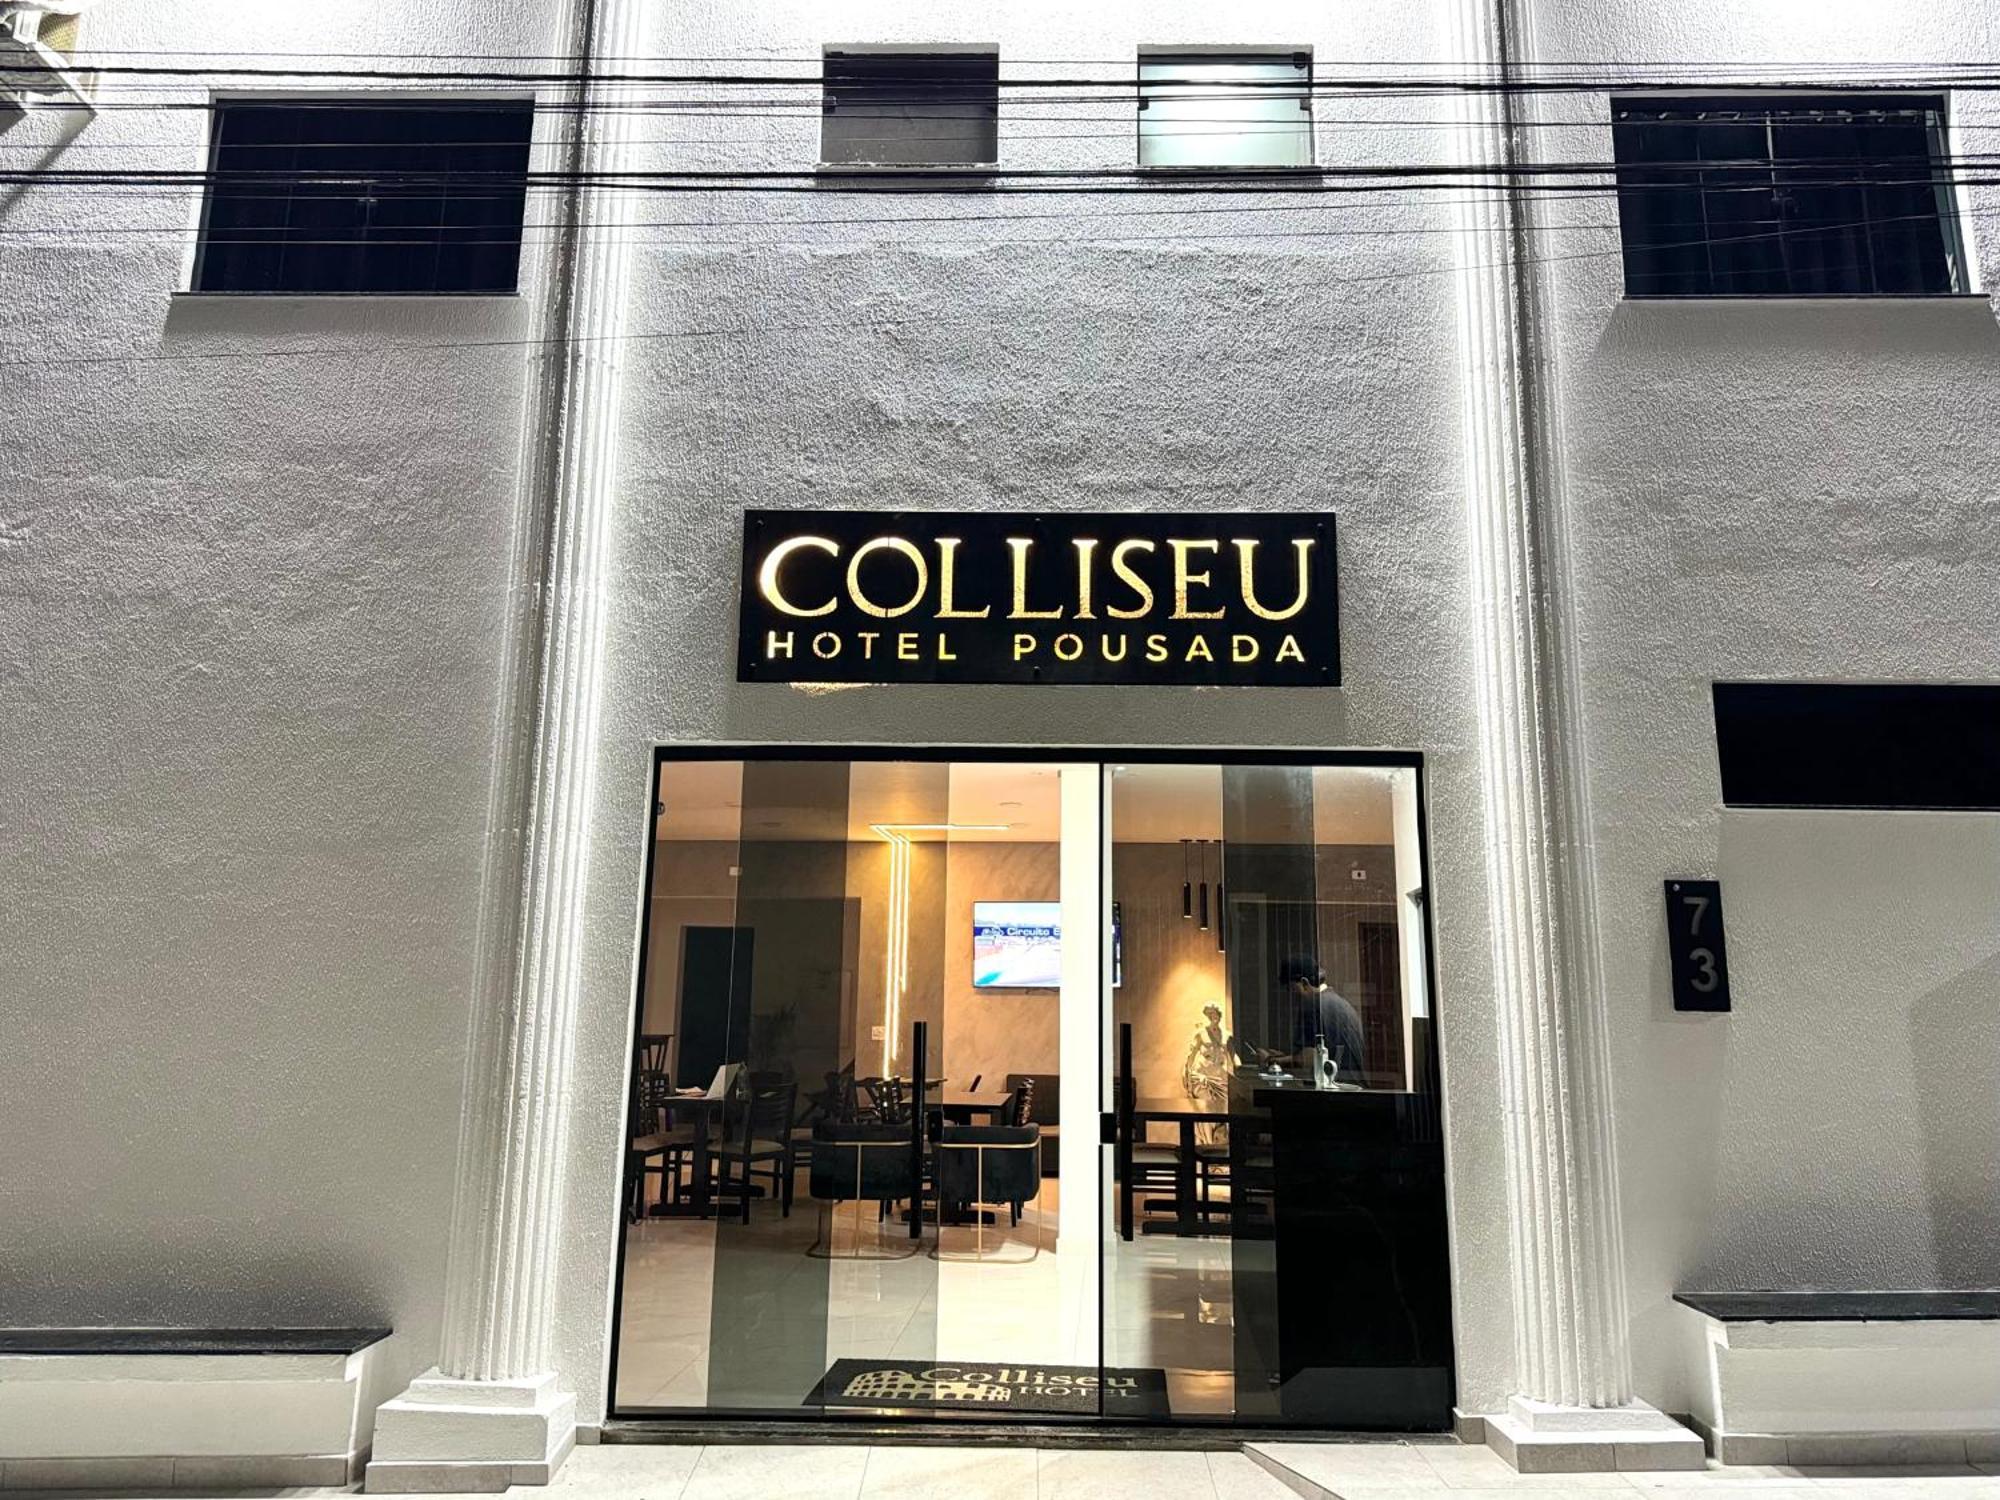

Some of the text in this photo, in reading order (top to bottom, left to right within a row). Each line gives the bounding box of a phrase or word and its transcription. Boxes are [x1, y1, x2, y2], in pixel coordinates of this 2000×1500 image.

[758, 535, 1316, 620] COLLISEU
[766, 631, 1306, 664] HOTEL POUSADA
[1006, 927, 1050, 937] Circuito
[920, 1367, 1138, 1388] Colliseu
